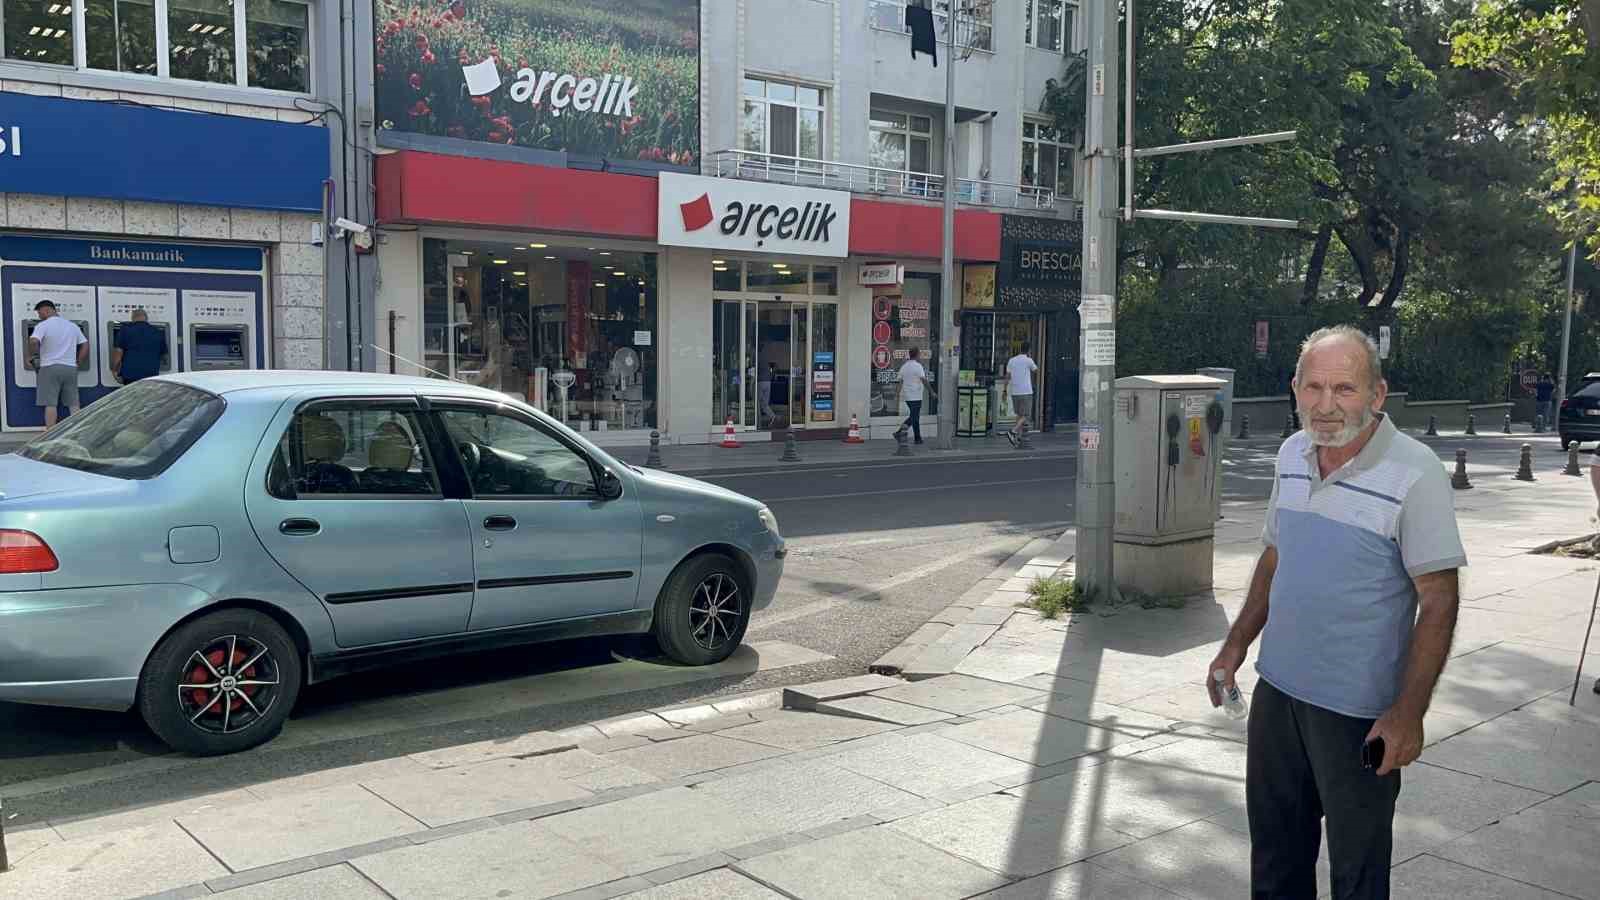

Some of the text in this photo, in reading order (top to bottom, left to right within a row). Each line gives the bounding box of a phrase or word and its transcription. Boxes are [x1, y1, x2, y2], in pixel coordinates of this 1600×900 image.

[510, 67, 639, 117] arçelik
[720, 201, 837, 247] arçelik
[90, 245, 185, 262] Bankamatik
[1021, 250, 1082, 271] BRESCIA
